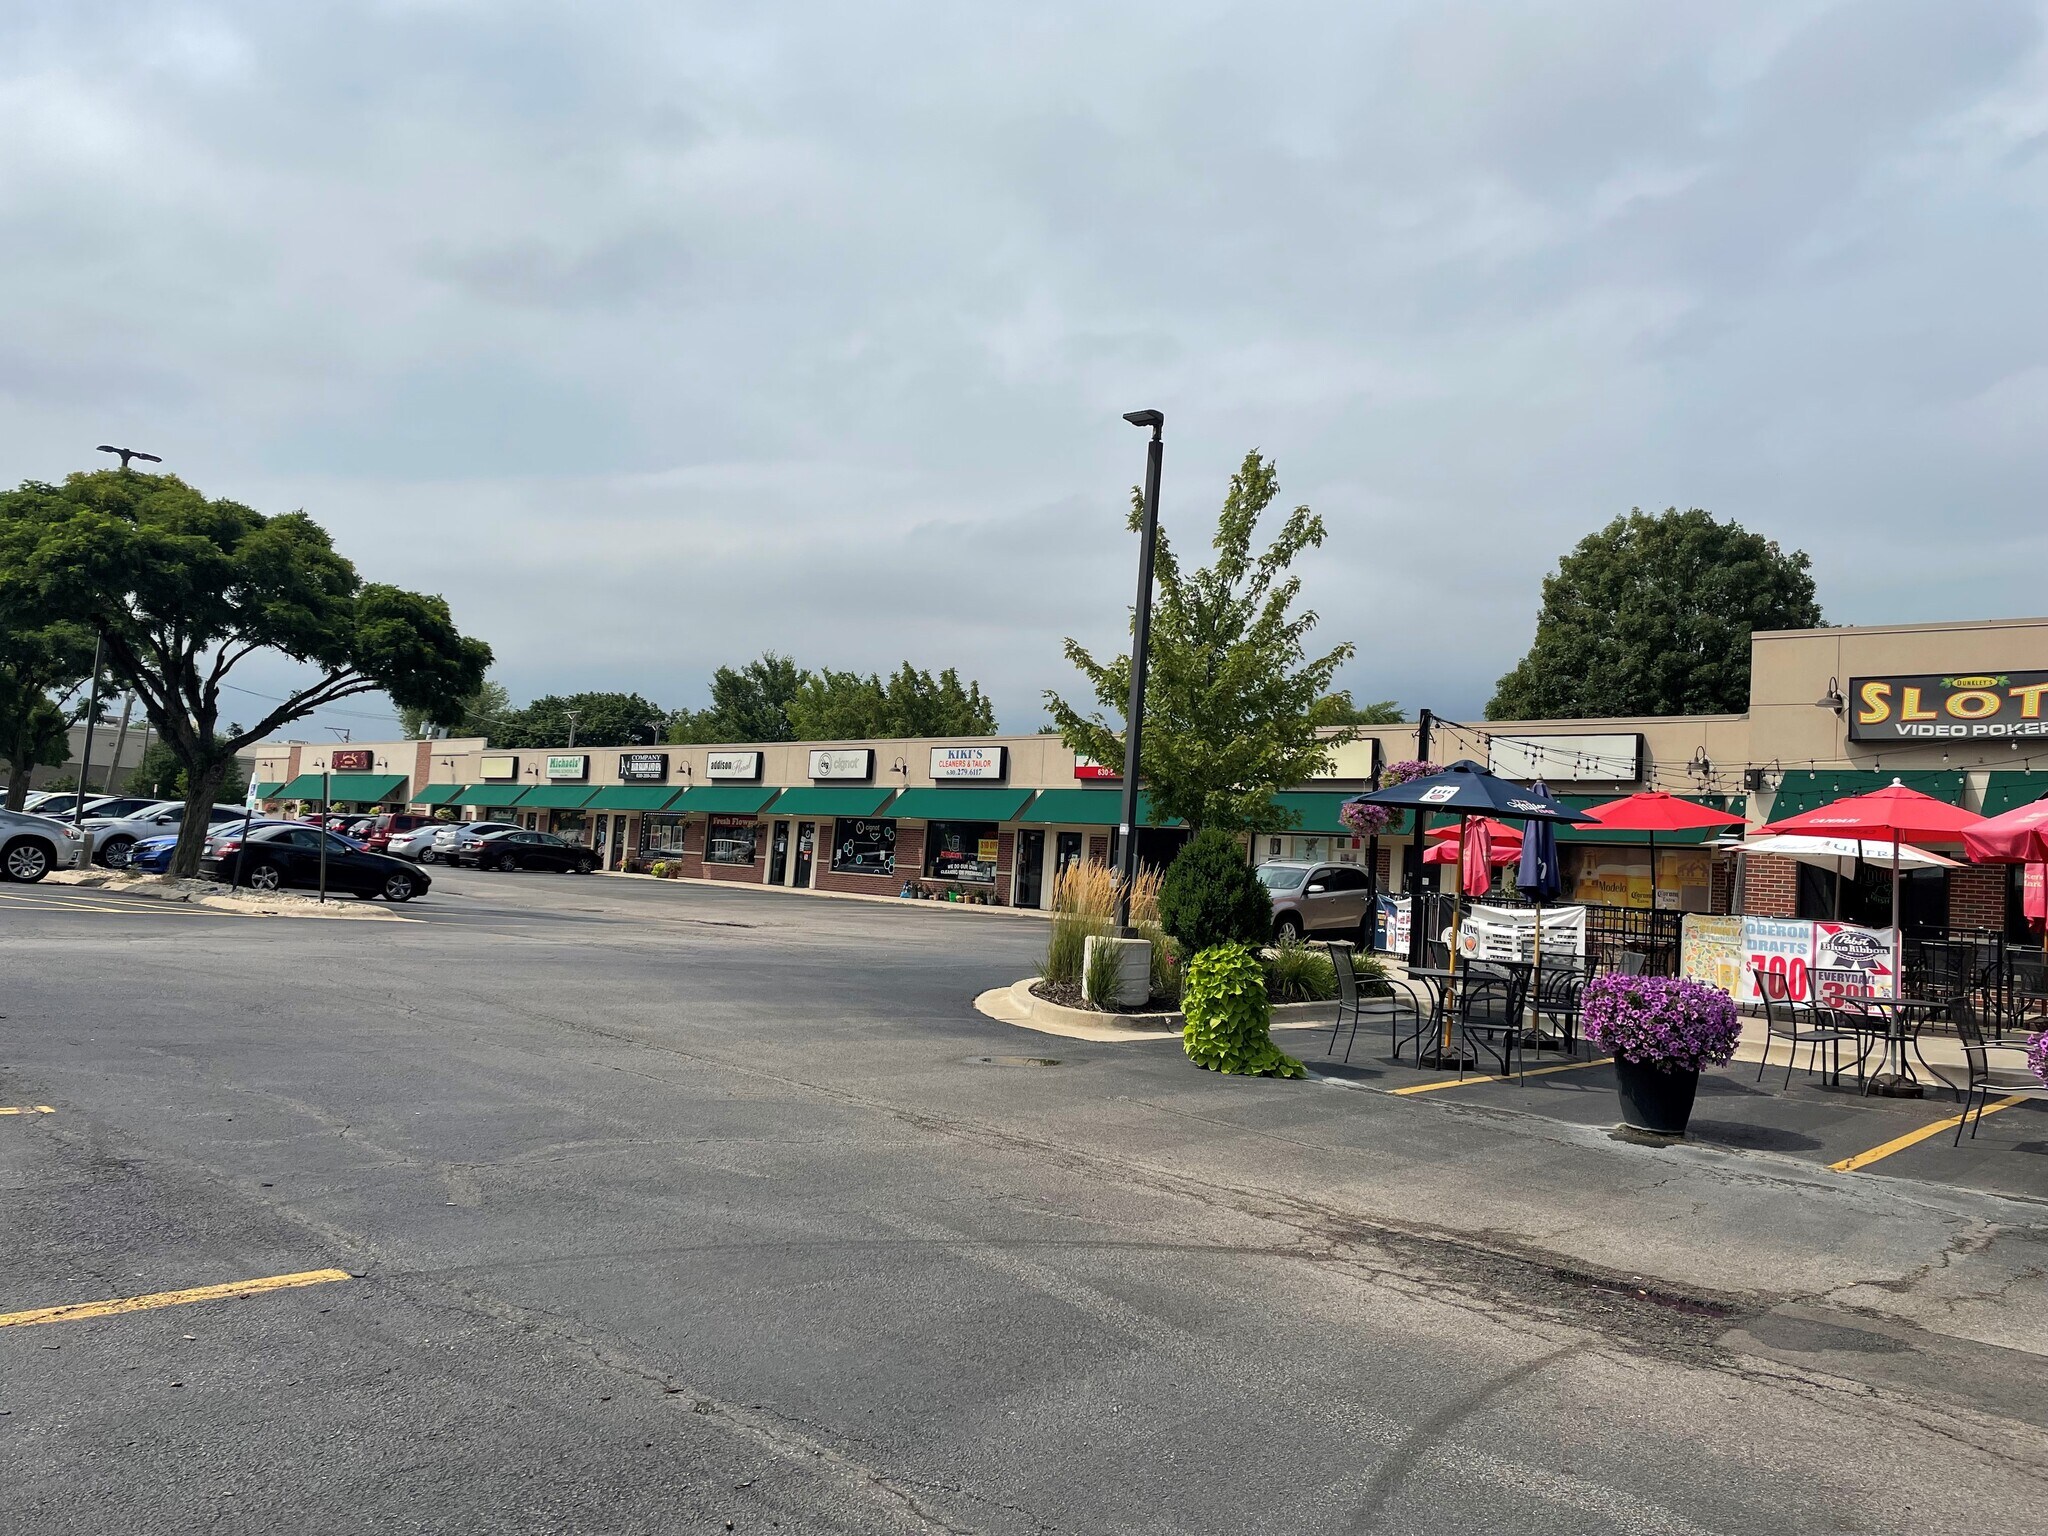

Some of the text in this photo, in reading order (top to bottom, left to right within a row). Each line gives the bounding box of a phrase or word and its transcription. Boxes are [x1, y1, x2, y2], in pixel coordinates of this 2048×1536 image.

[1895, 723, 1967, 736] VIDEO
[948, 749, 983, 759] KIKI'S
[711, 760, 732, 769] addison
[939, 760, 966, 768] CLEANERS
[972, 760, 992, 768] TAILOR
[1834, 843, 1905, 857] ULTRA
[1599, 881, 1627, 893] Modelo
[1657, 890, 1679, 898] Corona
[1463, 923, 1478, 935] Lite
[1745, 923, 1809, 939] OBERON
[1838, 934, 1870, 946] Pabst
[1746, 939, 1808, 955] DRAFTS
[1822, 942, 1848, 952] Blue
[1849, 945, 1888, 954] Ribbon
[1818, 971, 1876, 984] EVERYDAY!
